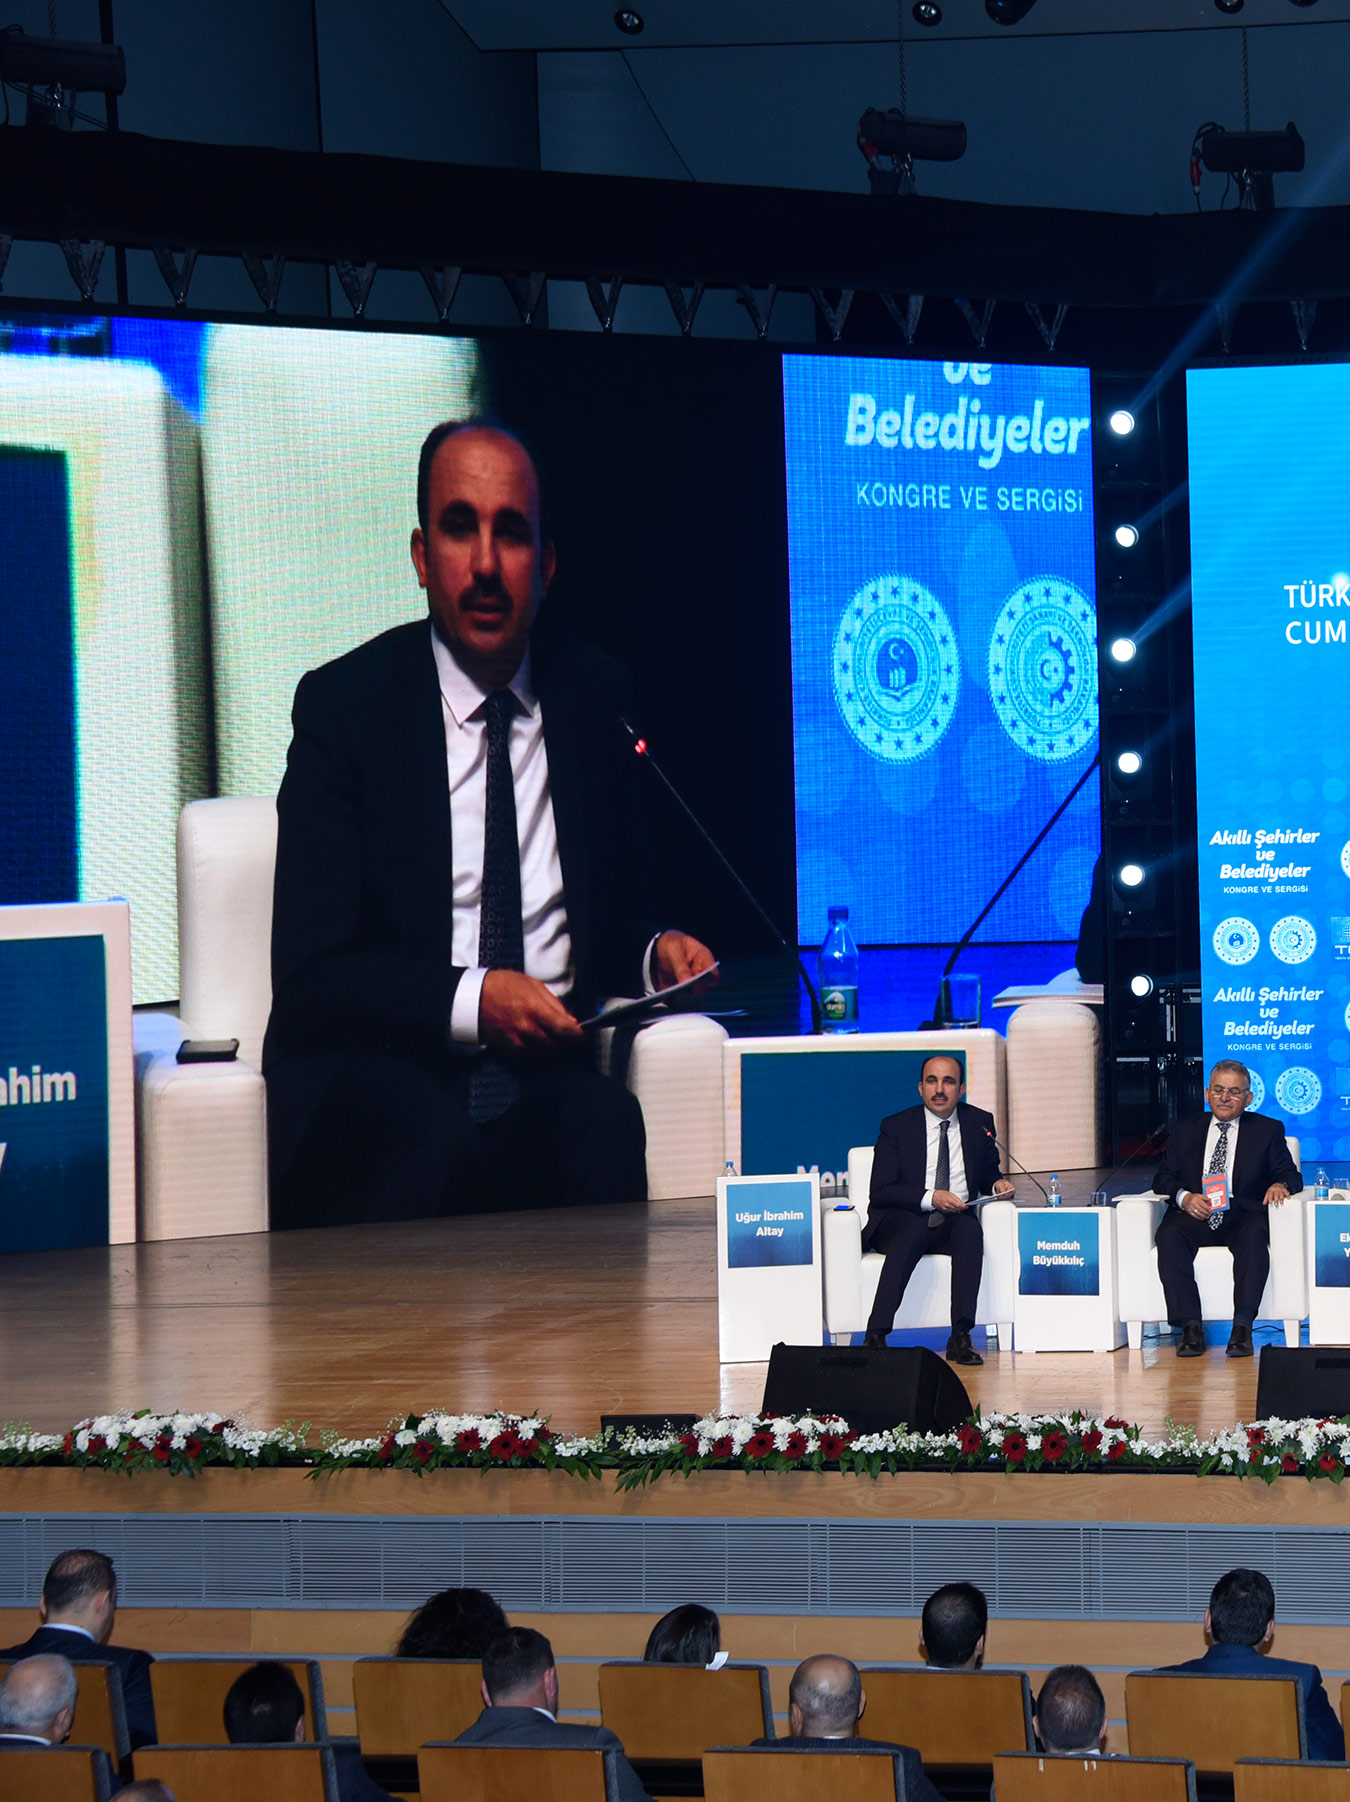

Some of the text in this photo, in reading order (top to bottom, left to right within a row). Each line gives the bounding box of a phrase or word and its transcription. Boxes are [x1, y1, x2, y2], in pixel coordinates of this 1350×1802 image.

[846, 394, 1089, 468] Belediyeler
[858, 483, 950, 508] KONGRE
[960, 488, 986, 509] VE
[1210, 828, 1320, 848] Akıllı Şehirler
[1256, 850, 1275, 861] ve
[1220, 863, 1311, 882] Belediyeler
[1224, 886, 1258, 894] KONGRE
[1213, 986, 1324, 1006] Akıllı Şehirler
[1260, 1008, 1279, 1018] ve
[1224, 1020, 1314, 1039] Belediyeler
[735, 1209, 805, 1225] Uğur İbrahim
[755, 1226, 785, 1238] Altay
[1037, 1240, 1081, 1251] Memduh
[1032, 1255, 1085, 1267] Büyükkılıç
